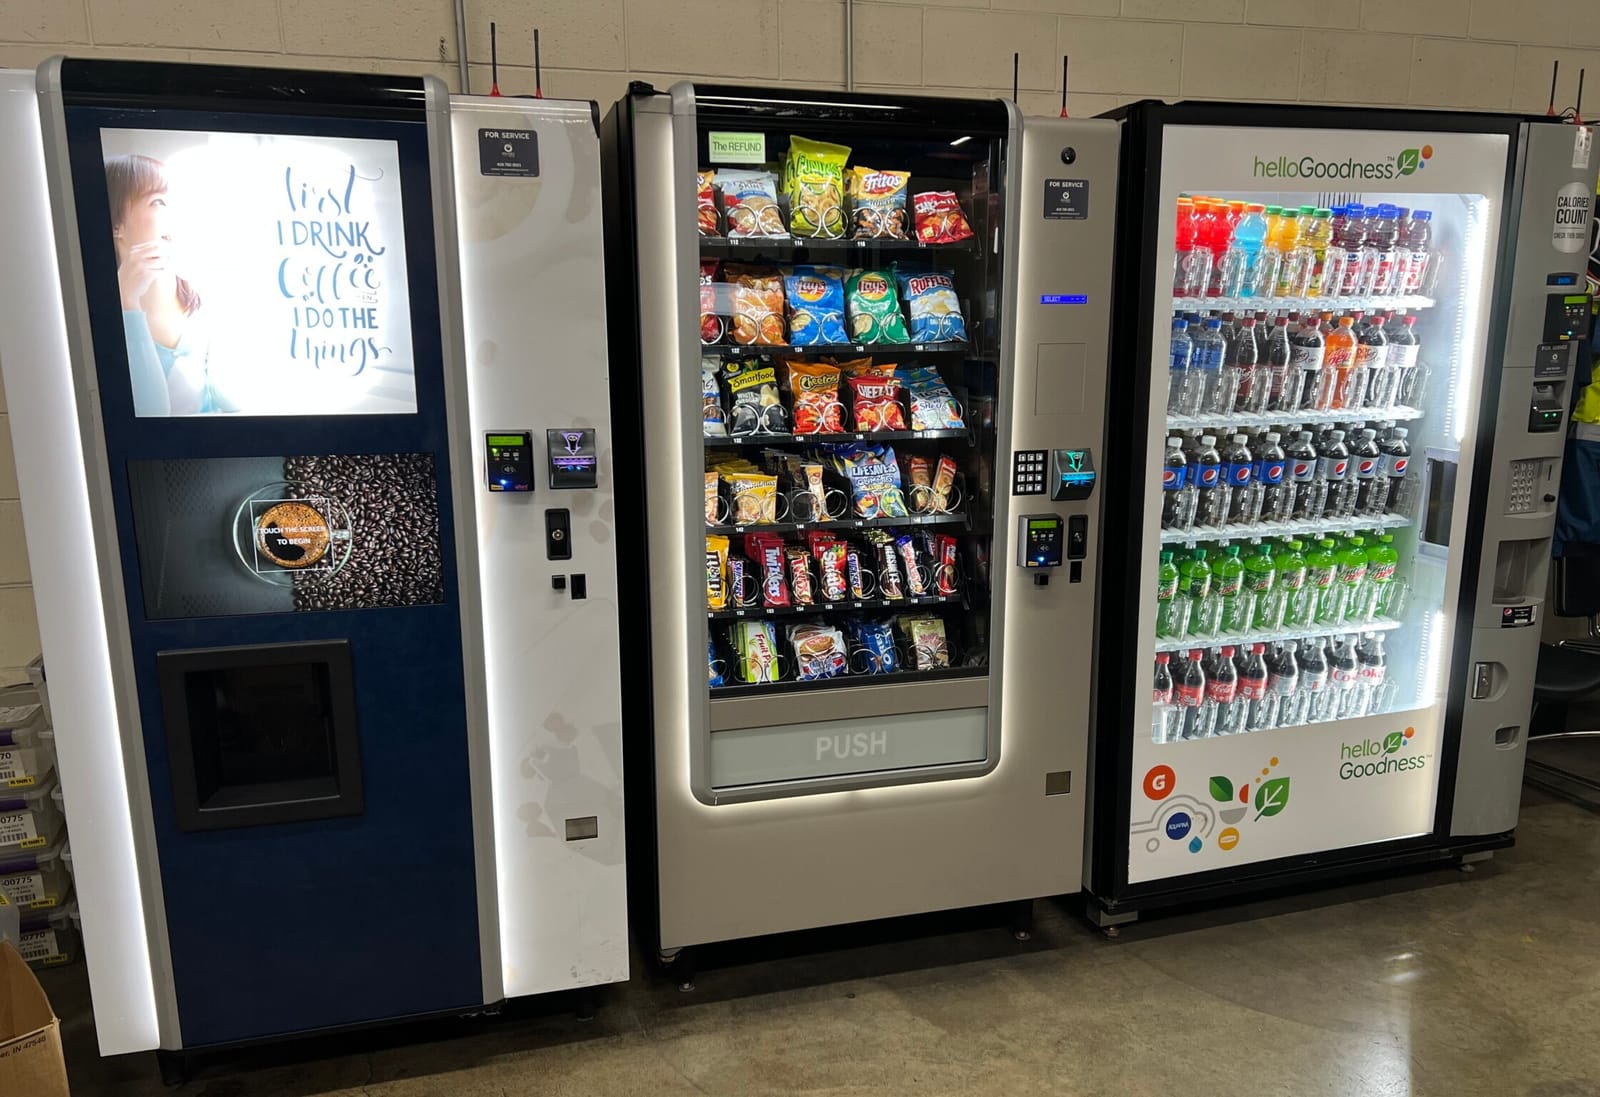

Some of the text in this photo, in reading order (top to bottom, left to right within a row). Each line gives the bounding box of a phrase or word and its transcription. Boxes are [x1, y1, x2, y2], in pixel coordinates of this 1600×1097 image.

[485, 131, 530, 140] FOR SERVICE
[713, 141, 761, 151] The REFUND
[1253, 156, 1393, 179] helloGoodness
[863, 172, 902, 192] Fritos
[1556, 208, 1588, 225] COUNT
[277, 220, 386, 259] I DRINK
[294, 306, 379, 328] I DO THE
[800, 375, 838, 391] Cheetos
[260, 525, 326, 535] TOUCH THE SCREEN
[276, 537, 311, 546] TO BEGIN
[816, 730, 887, 761] PUSH
[1340, 738, 1381, 760] hello
[1339, 756, 1425, 780] Goodness
[1152, 774, 1166, 791] G
